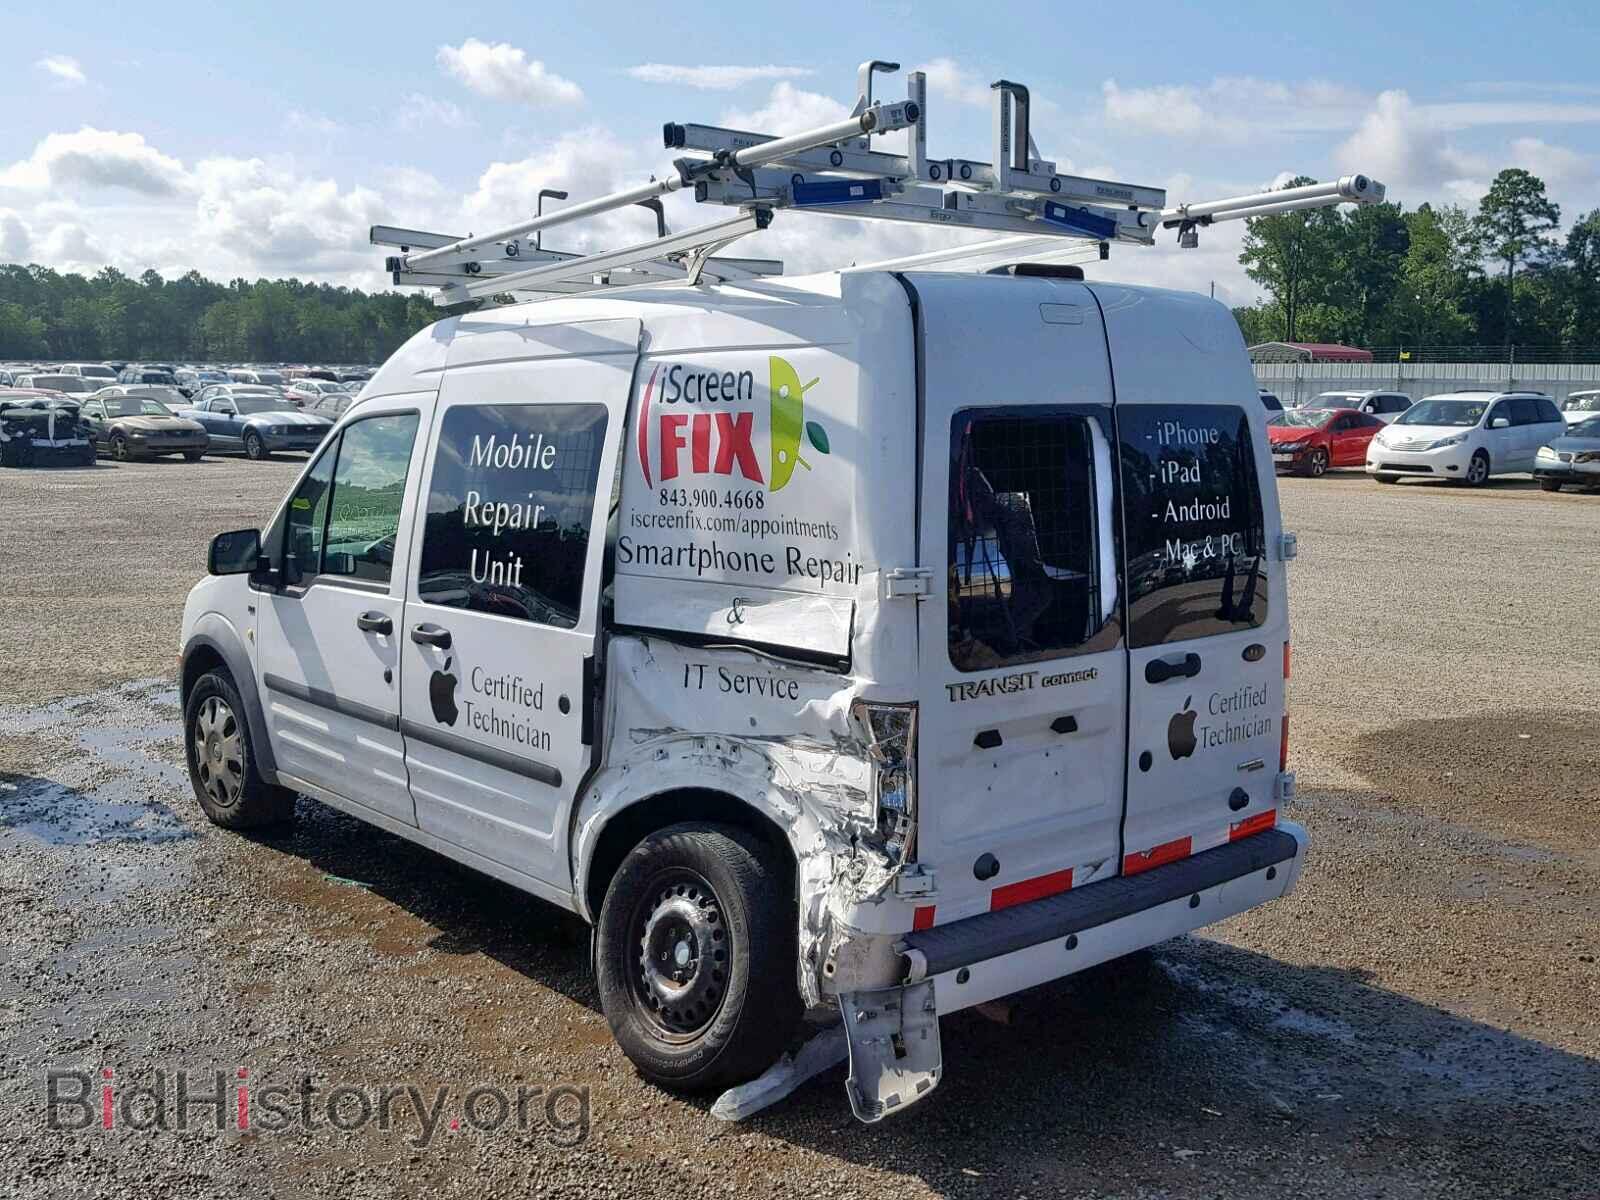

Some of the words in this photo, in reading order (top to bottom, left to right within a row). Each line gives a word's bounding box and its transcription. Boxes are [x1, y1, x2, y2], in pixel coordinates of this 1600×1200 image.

[658, 364, 754, 404] iScreen
[660, 411, 765, 485] FIX
[1157, 421, 1219, 445] iPhone
[470, 433, 556, 470] Mobile
[1161, 459, 1201, 484] iPad
[463, 490, 545, 536] Repair
[660, 488, 765, 509] 843.900.4668
[1164, 495, 1231, 522] Android
[631, 507, 839, 541] iscreenfix.com/appointments
[617, 535, 775, 576] Smartphone
[786, 546, 864, 589] Repair
[1165, 538, 1198, 561] Mac
[1202, 535, 1216, 558] &
[1221, 532, 1241, 557] PC
[470, 548, 524, 588] Unit
[726, 597, 745, 624] &
[471, 666, 544, 711] Certified
[684, 663, 708, 689] IT
[718, 666, 799, 700] Service
[945, 671, 1039, 702] TRANSIT
[1041, 667, 1098, 688] connect
[1208, 681, 1267, 715] Certified
[463, 700, 551, 752] Technician
[1200, 715, 1272, 749] Technician
